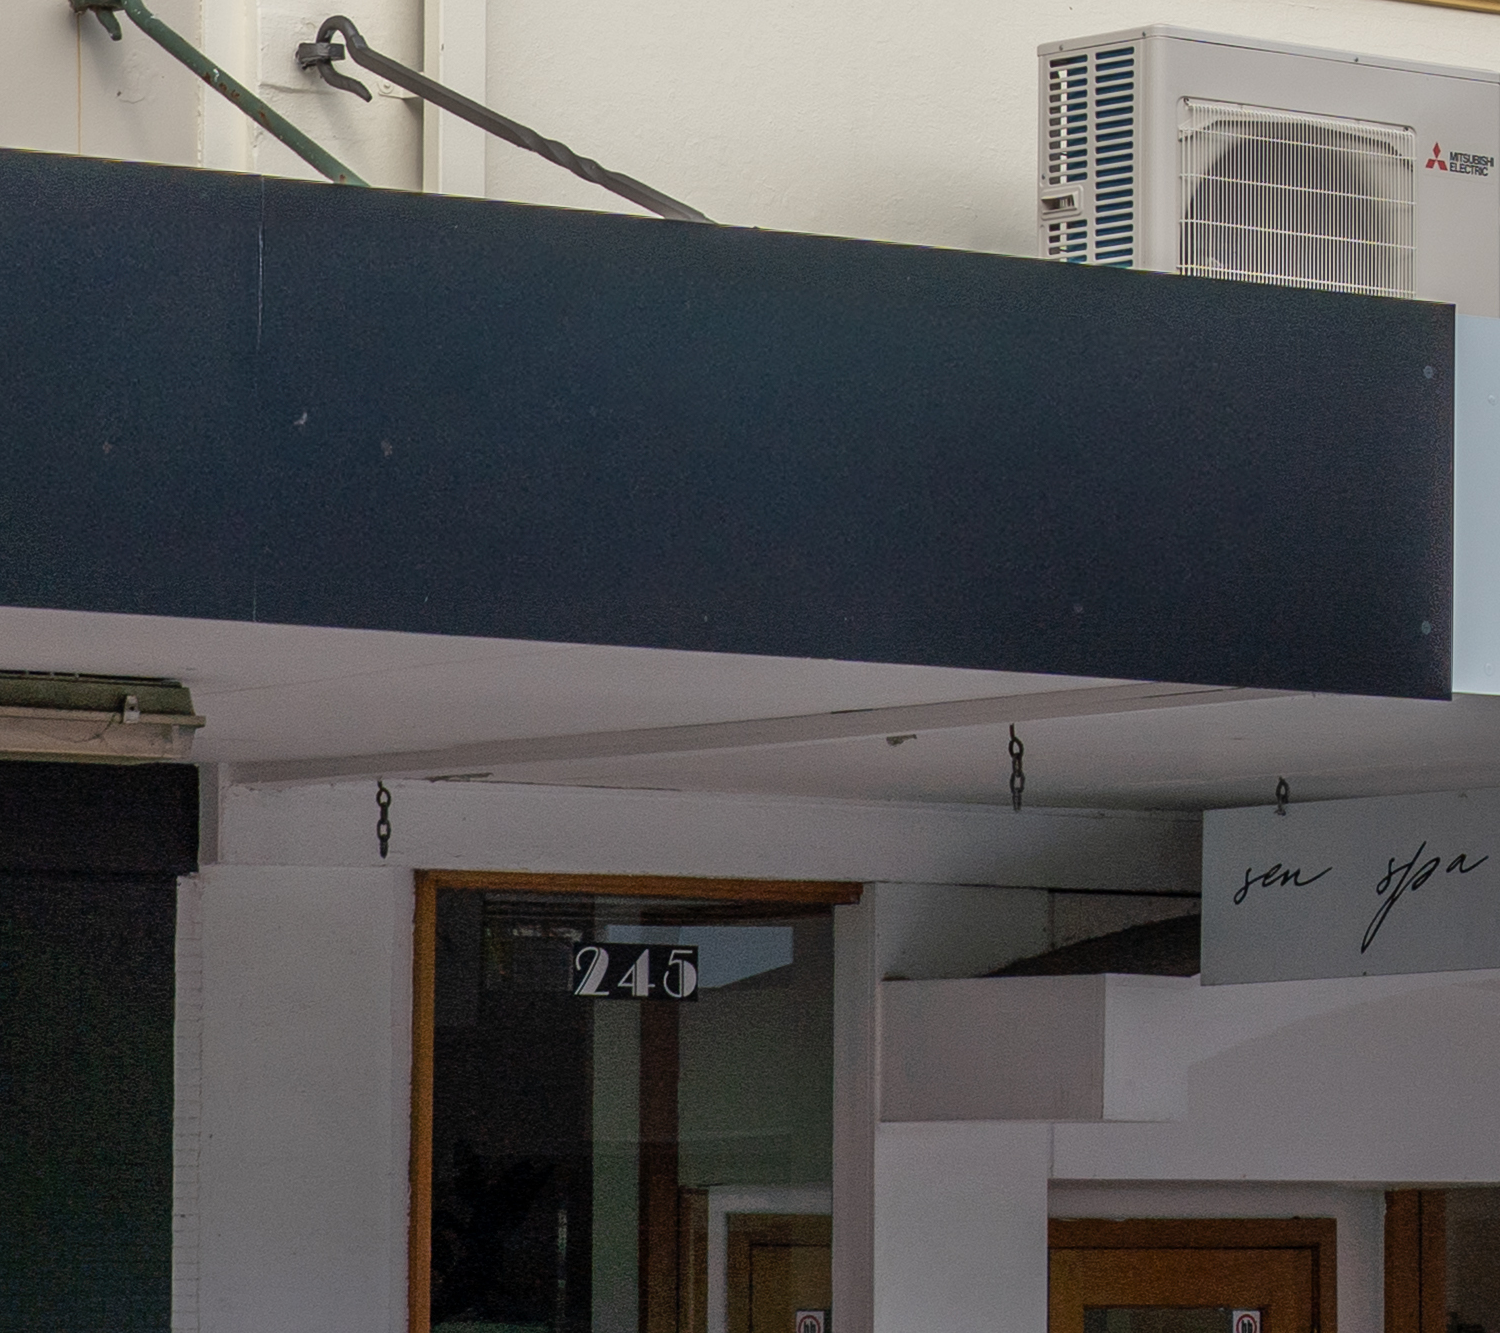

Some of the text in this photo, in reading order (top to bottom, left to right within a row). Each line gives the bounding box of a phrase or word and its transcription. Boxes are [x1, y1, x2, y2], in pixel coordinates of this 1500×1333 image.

[1449, 151, 1495, 168] MITSUBISHI
[1449, 162, 1489, 177] ELECTRIC
[1359, 840, 1489, 955] spa
[573, 945, 698, 999] 245
